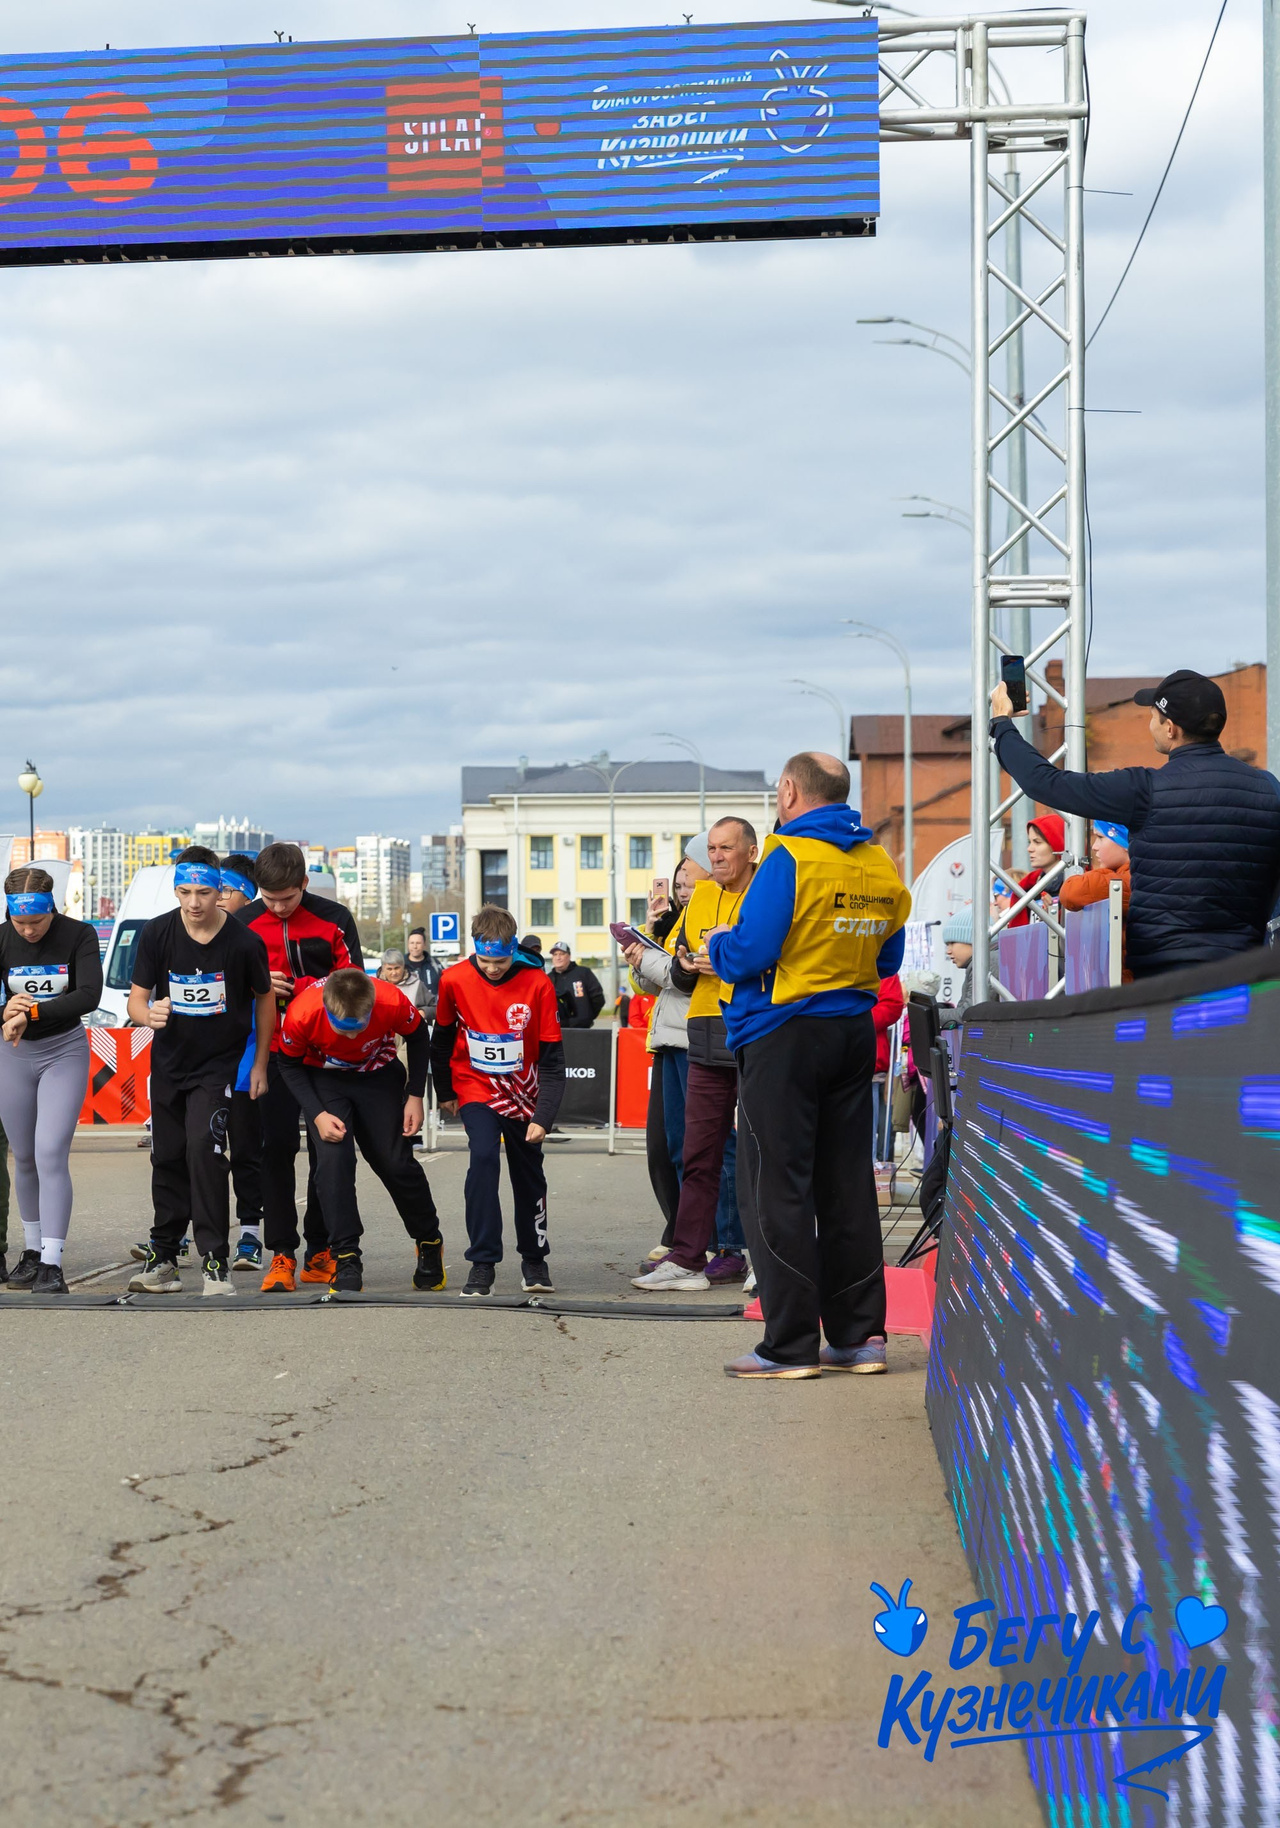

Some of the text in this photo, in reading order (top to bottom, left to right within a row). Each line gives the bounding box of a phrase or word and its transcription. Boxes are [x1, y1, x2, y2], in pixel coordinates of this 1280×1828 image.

[437, 915, 455, 940] P
[24, 979, 54, 994] 64
[183, 988, 211, 1003] 52
[484, 1046, 505, 1061] 51
